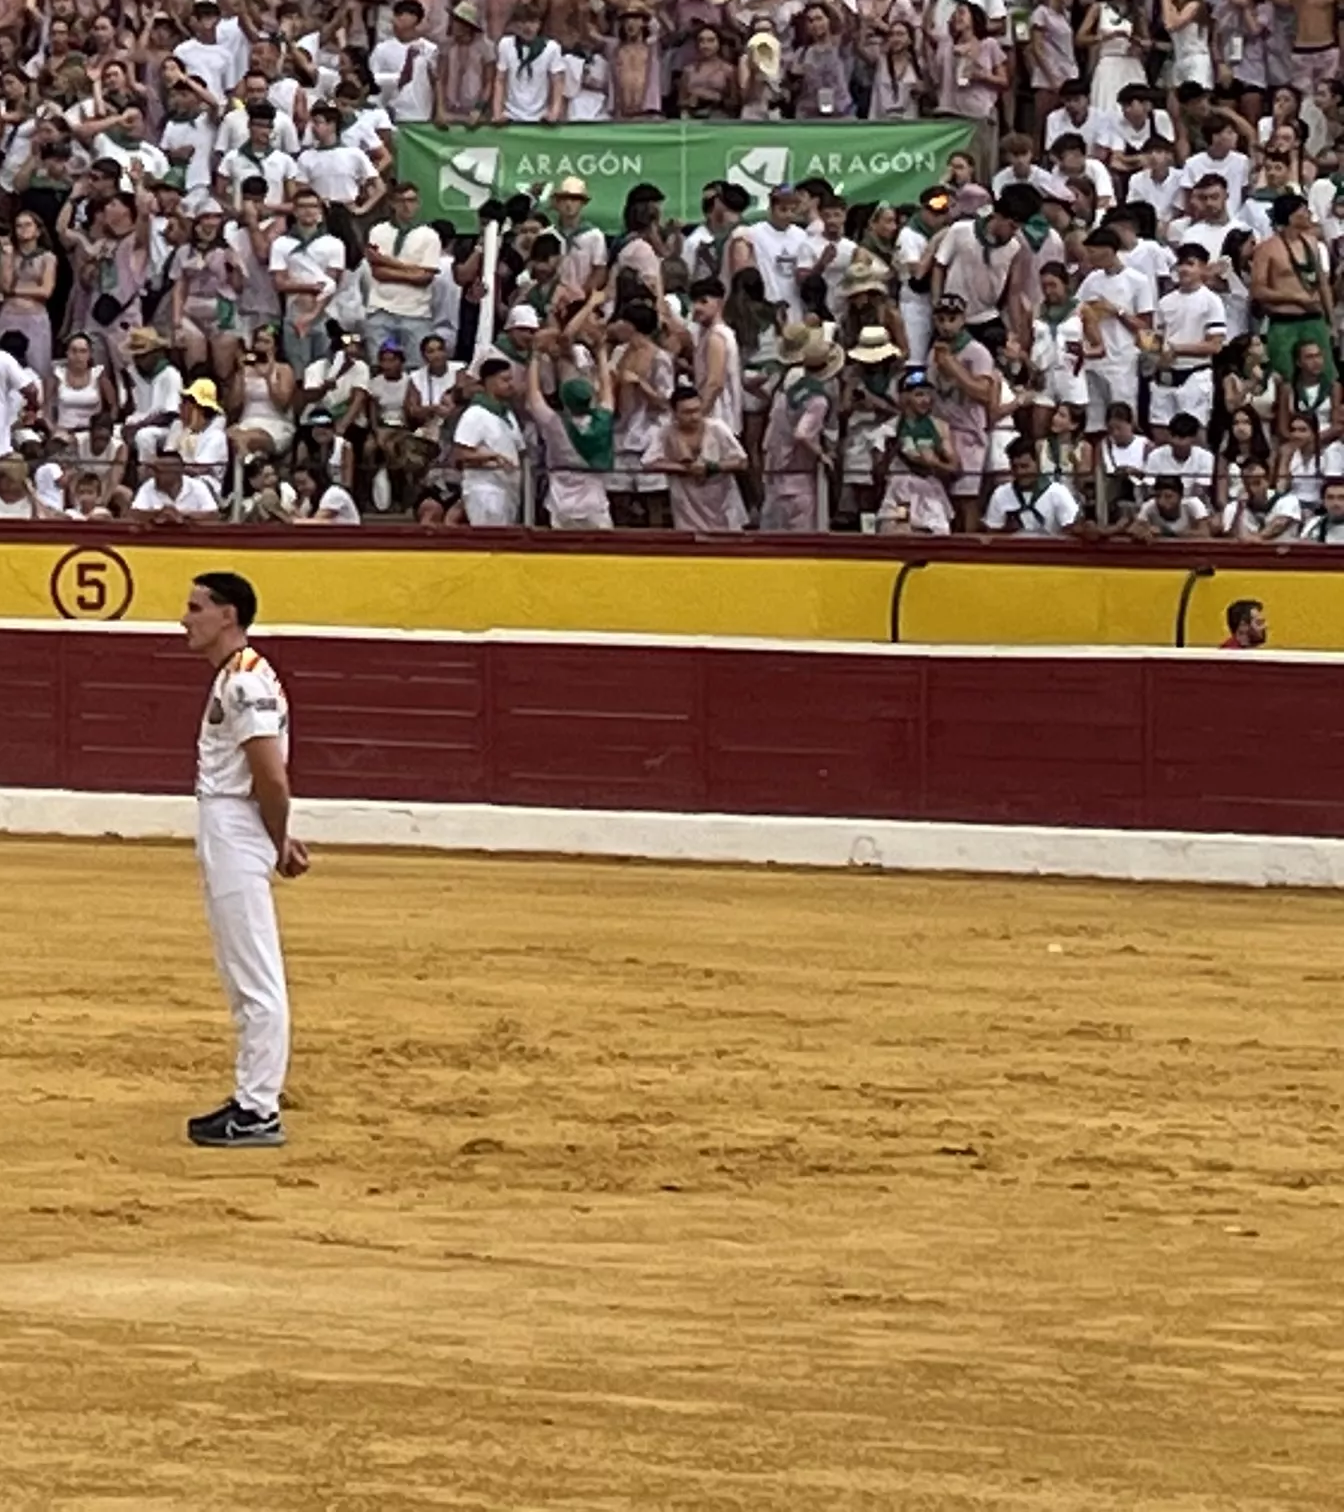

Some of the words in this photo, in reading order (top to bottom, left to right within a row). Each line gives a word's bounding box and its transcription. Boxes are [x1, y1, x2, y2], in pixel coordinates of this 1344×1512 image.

[516, 149, 643, 176] ARAGÓN
[806, 148, 937, 175] ARAGÓN
[76, 562, 107, 611] 5
